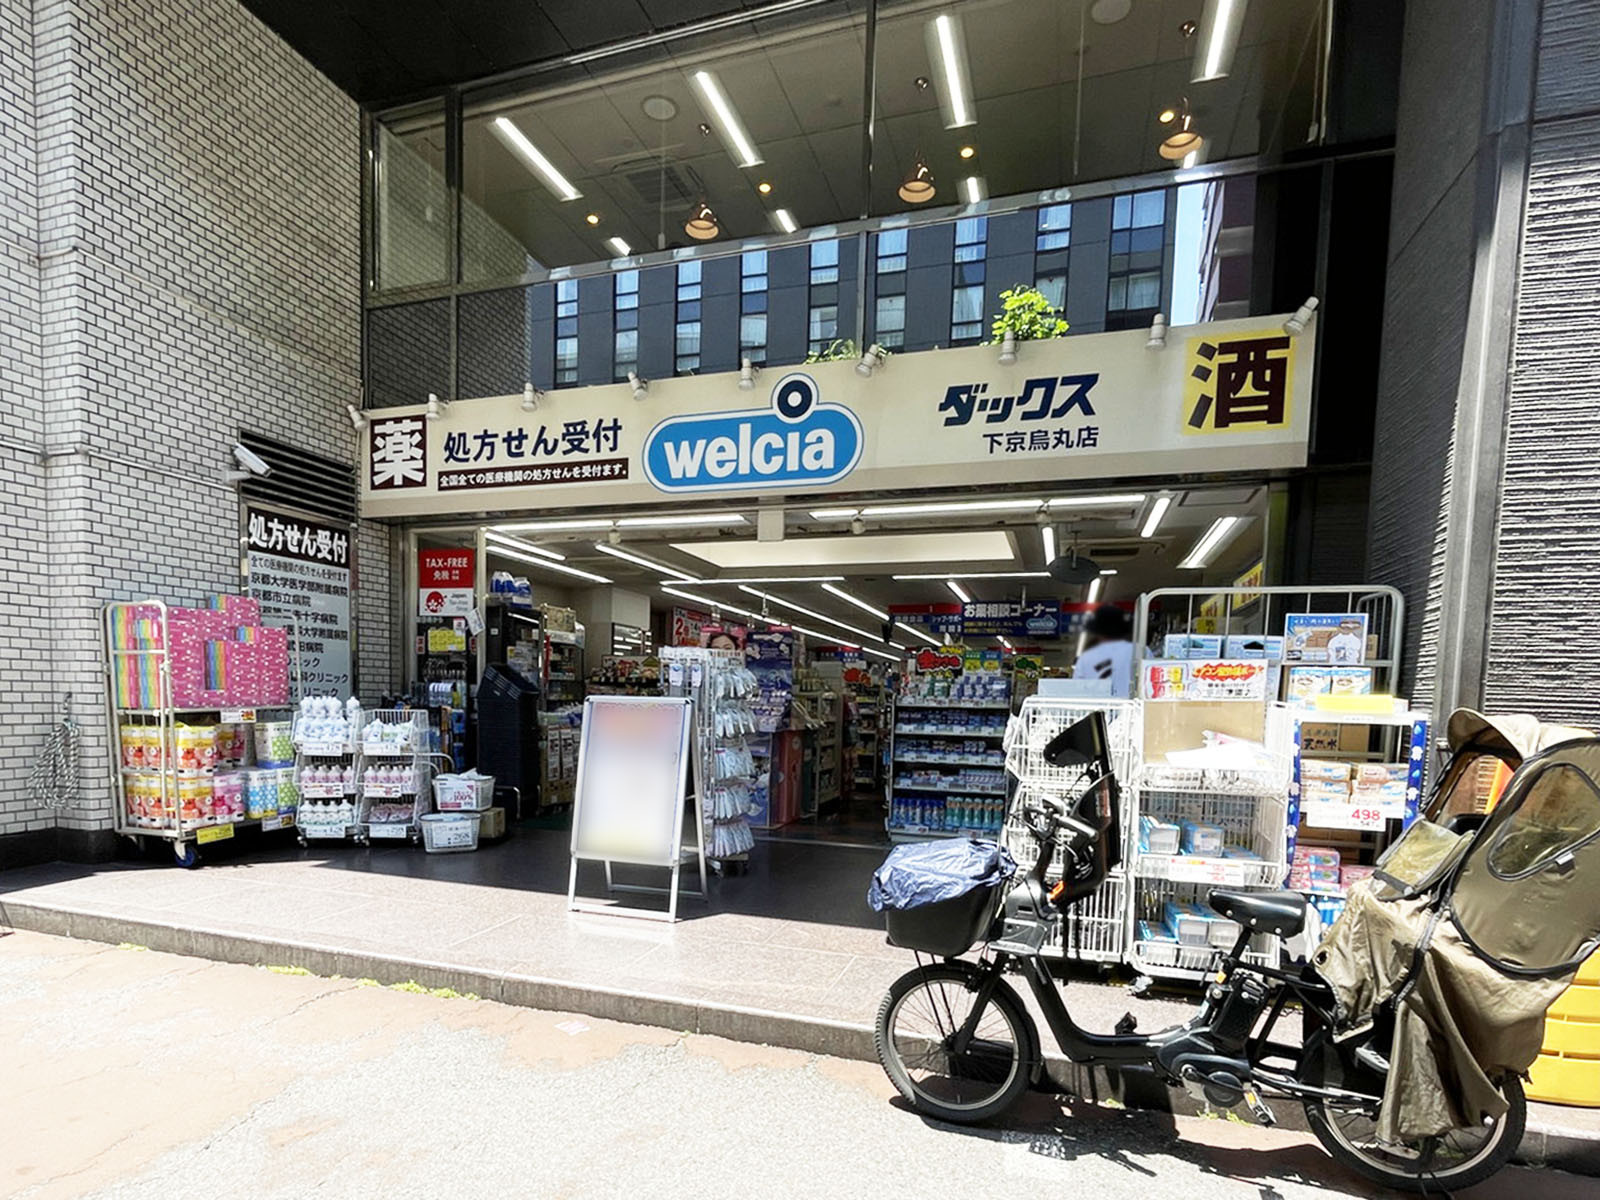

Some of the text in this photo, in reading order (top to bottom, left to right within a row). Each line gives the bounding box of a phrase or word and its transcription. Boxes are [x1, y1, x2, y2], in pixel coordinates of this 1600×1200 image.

[938, 373, 1099, 427] ダックス
[1188, 336, 1290, 429] 酒
[372, 419, 425, 486] 薬
[443, 418, 622, 463] 処方せん受付
[663, 422, 835, 479] welcia
[982, 426, 1099, 455] 下京烏丸店
[249, 512, 348, 564] 処方せん受付
[251, 572, 348, 598] 京都大学医学部附属病院
[251, 588, 311, 607] 京都市立病院
[1303, 737, 1337, 751] 天然水
[1351, 809, 1381, 821] 498
